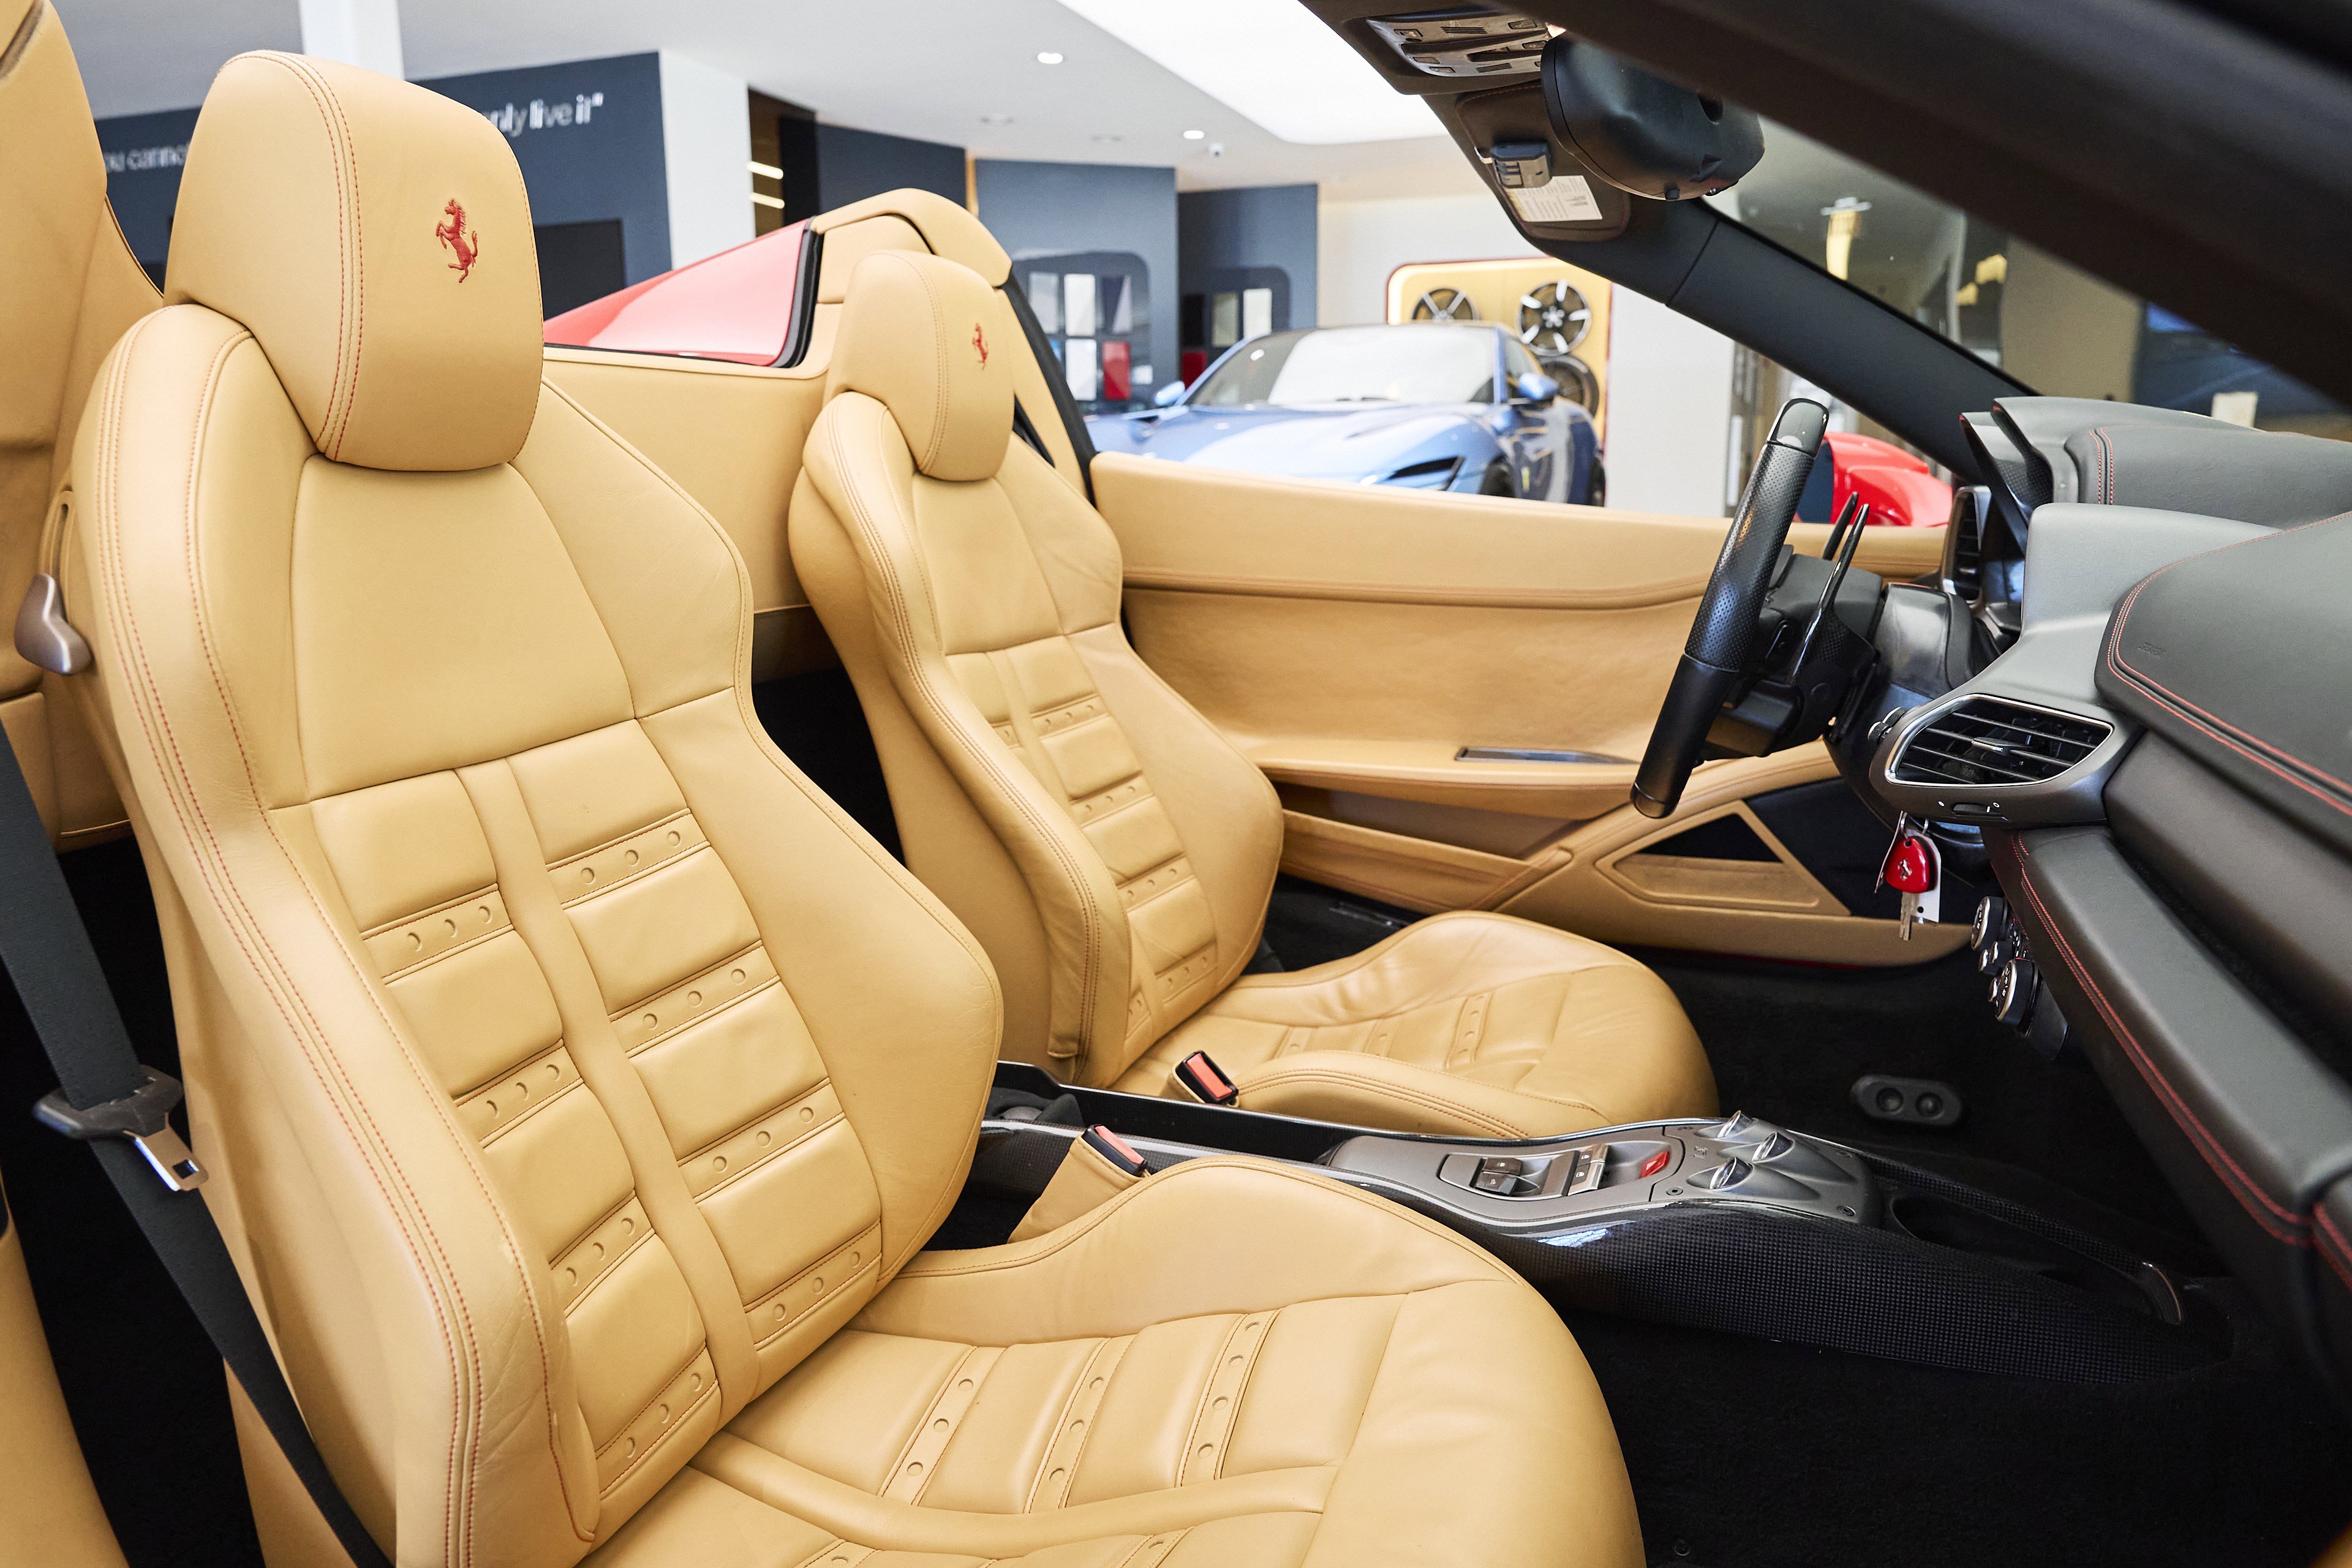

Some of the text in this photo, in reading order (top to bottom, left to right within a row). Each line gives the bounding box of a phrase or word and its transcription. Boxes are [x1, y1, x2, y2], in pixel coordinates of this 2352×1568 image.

[126, 143, 189, 171] canno
[483, 102, 528, 137] nly
[529, 98, 573, 129] live
